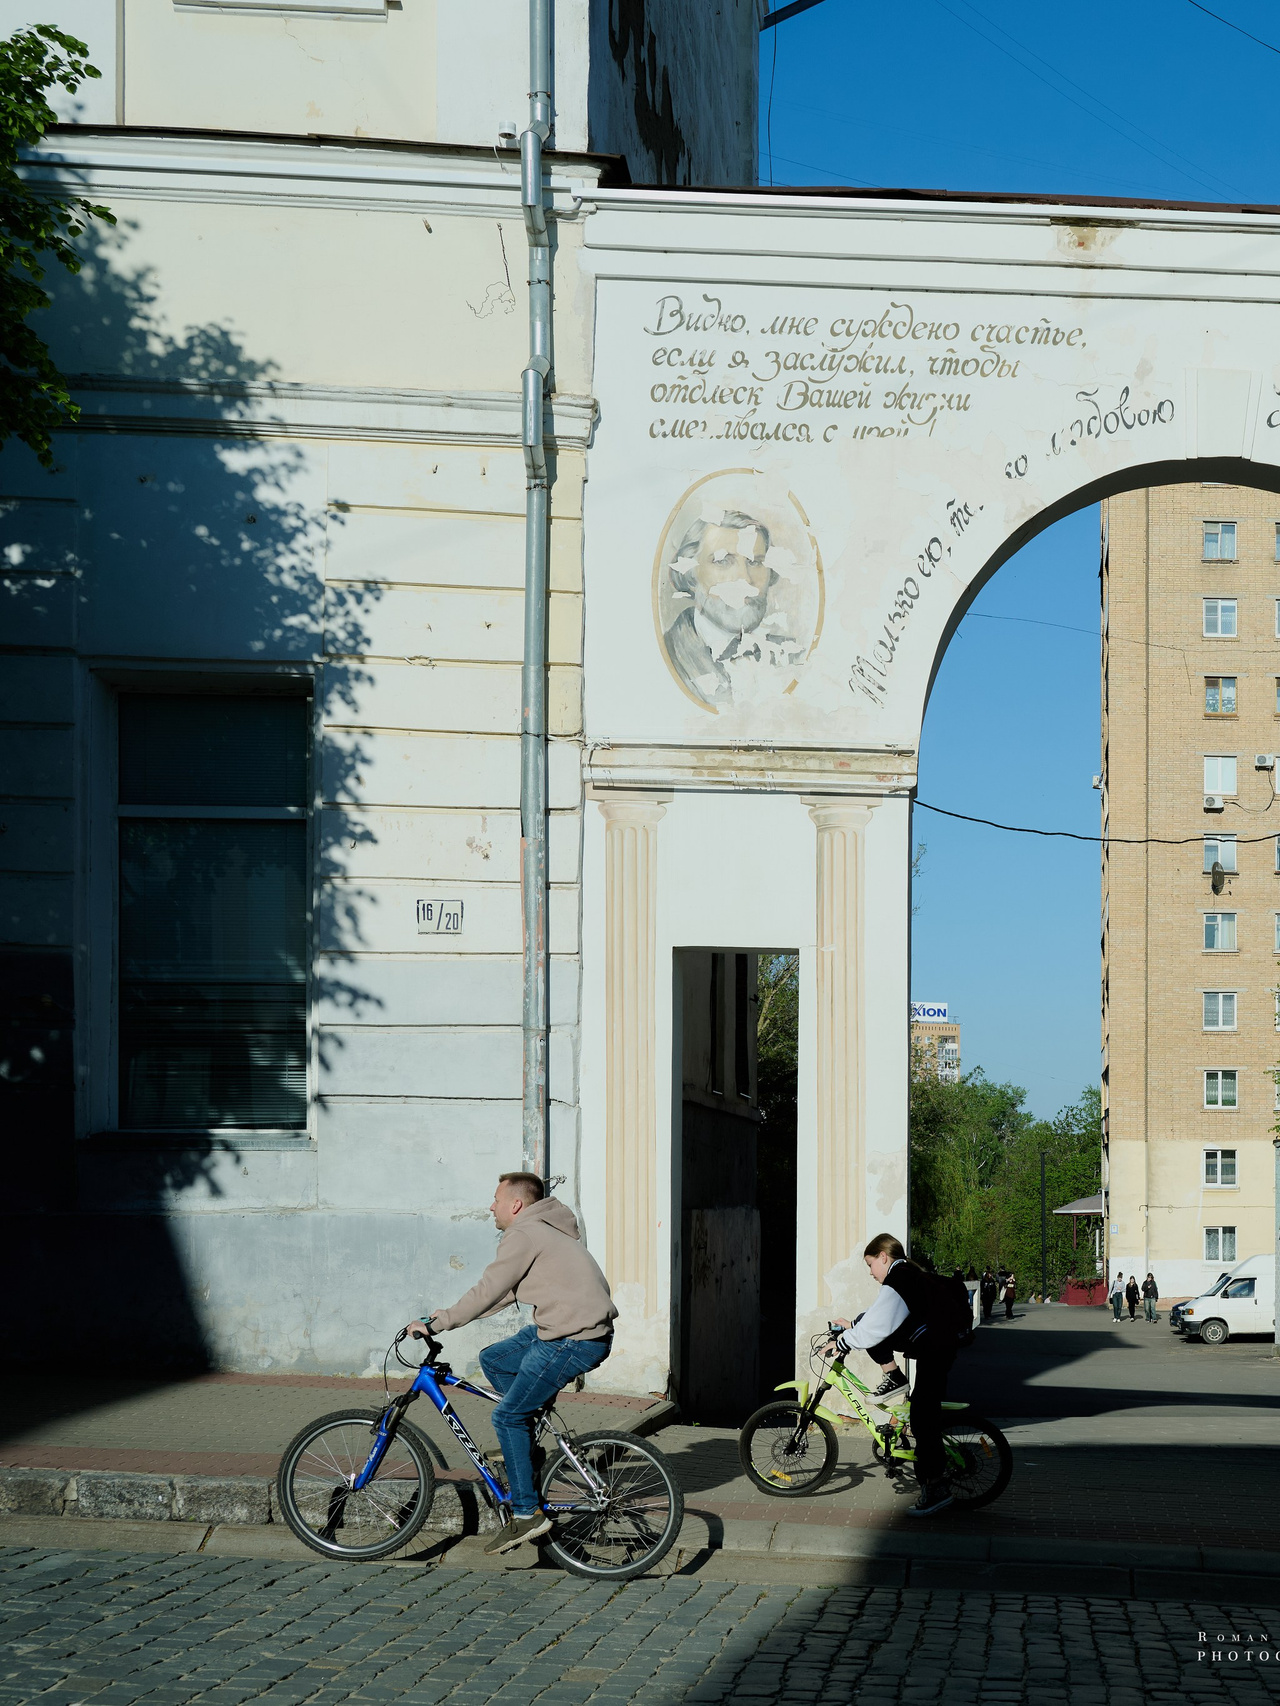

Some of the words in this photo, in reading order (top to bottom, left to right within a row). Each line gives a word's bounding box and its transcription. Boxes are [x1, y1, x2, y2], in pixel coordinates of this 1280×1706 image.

[760, 315, 819, 336] мне
[822, 301, 961, 353] суждено
[970, 317, 1087, 350] счастье,
[651, 346, 717, 368] если
[727, 350, 750, 369] я
[751, 342, 915, 384] заслужил,
[926, 344, 1021, 379] чтобы
[649, 369, 765, 405] отблеск
[775, 380, 873, 411] Вашей
[648, 407, 815, 444] смеивался
[822, 424, 839, 443] с
[421, 902, 460, 931] 16/20
